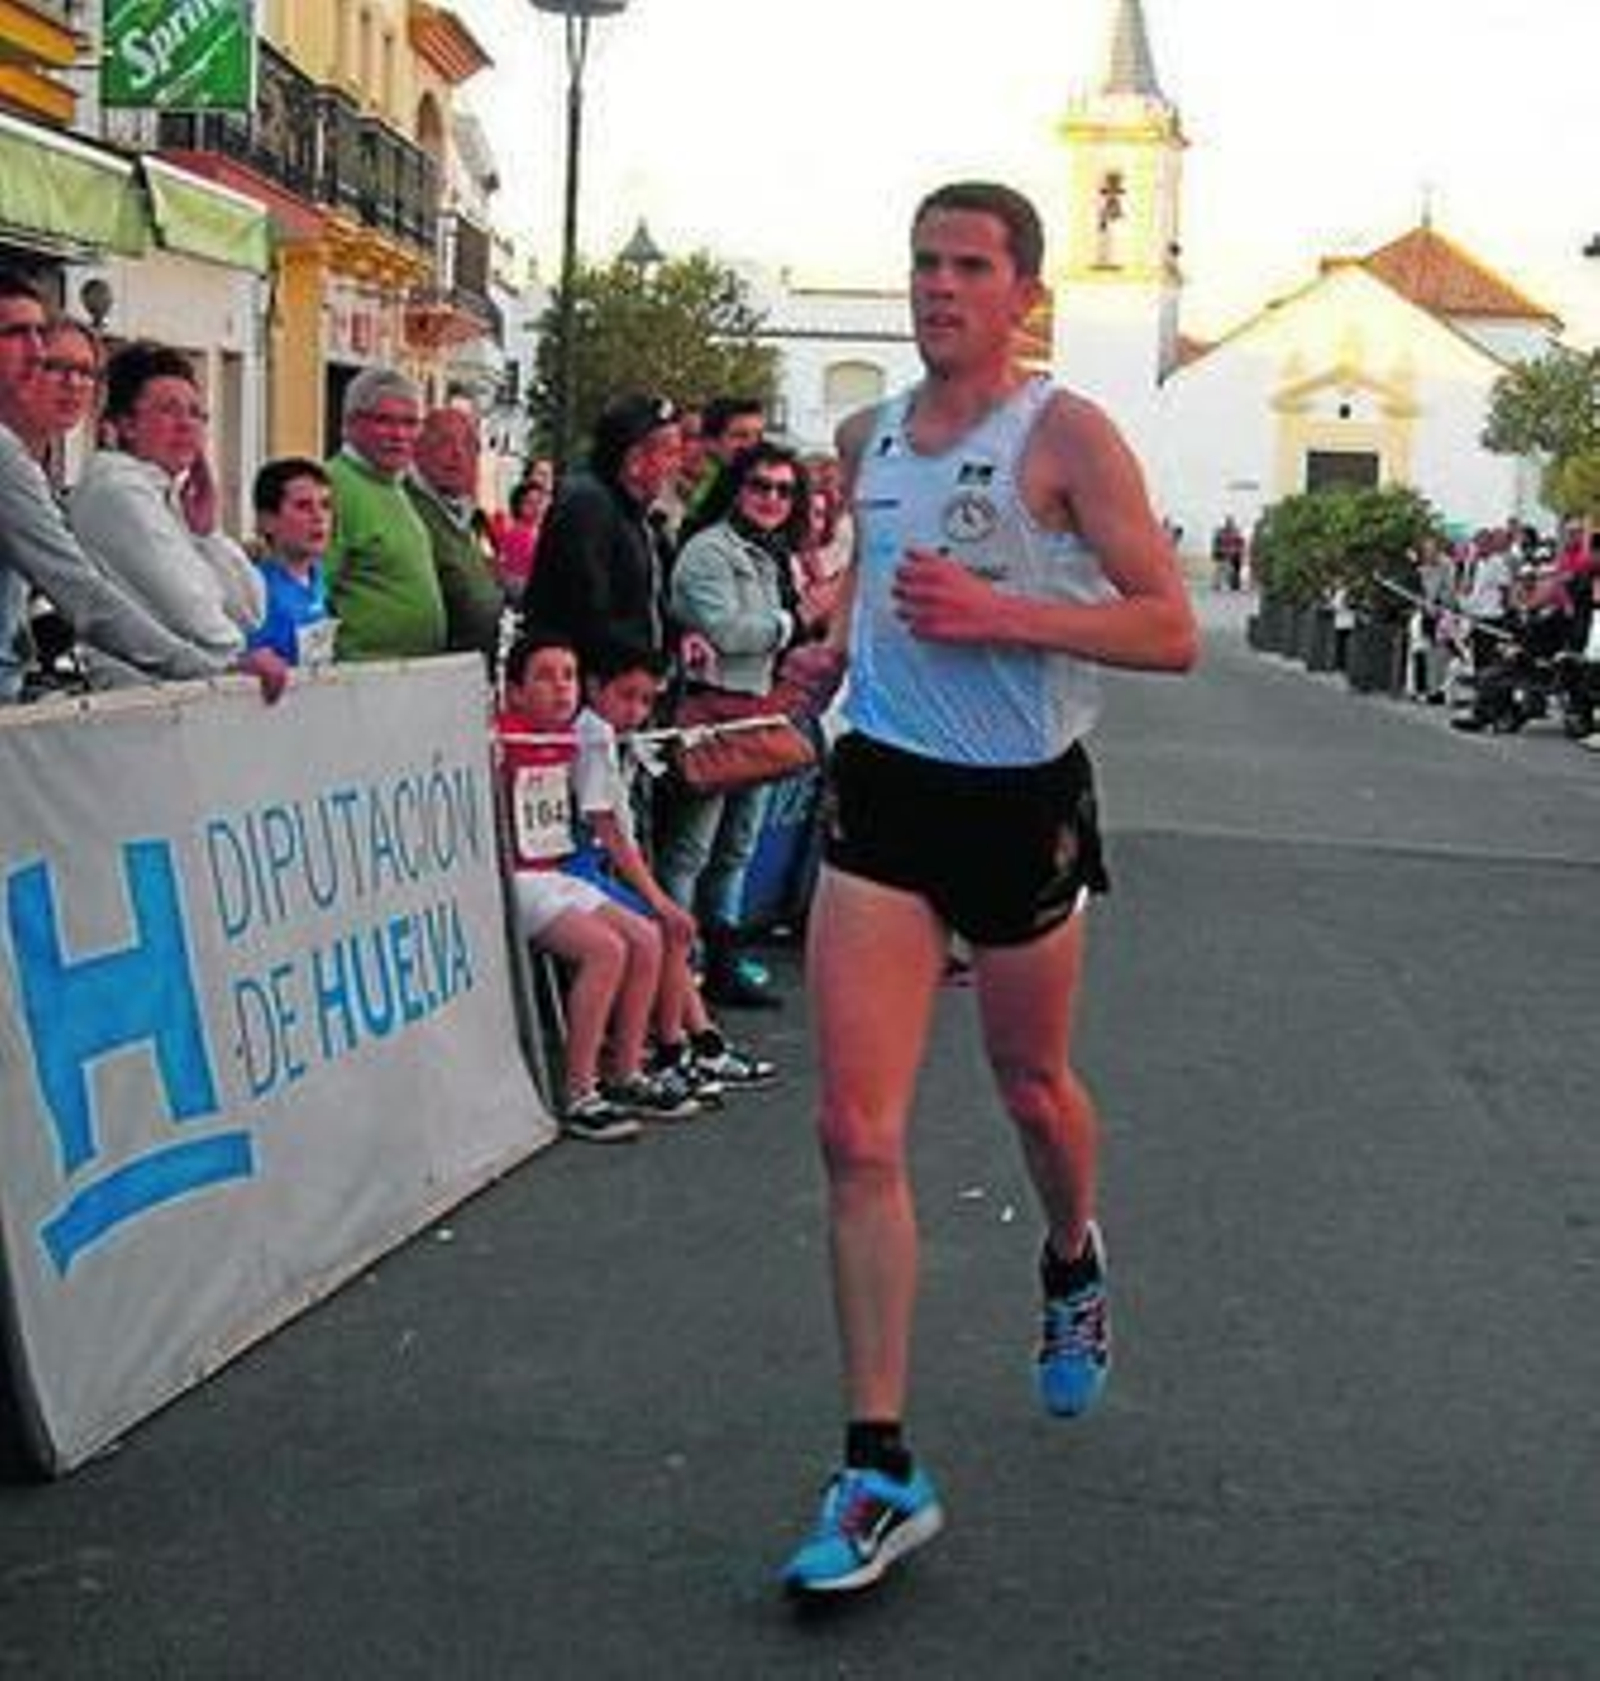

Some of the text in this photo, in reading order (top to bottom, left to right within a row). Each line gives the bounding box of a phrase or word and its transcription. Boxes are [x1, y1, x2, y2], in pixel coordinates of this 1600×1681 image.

[207, 749, 481, 938] DIPUTACIÓN
[234, 898, 473, 1096] DE HUELVA
